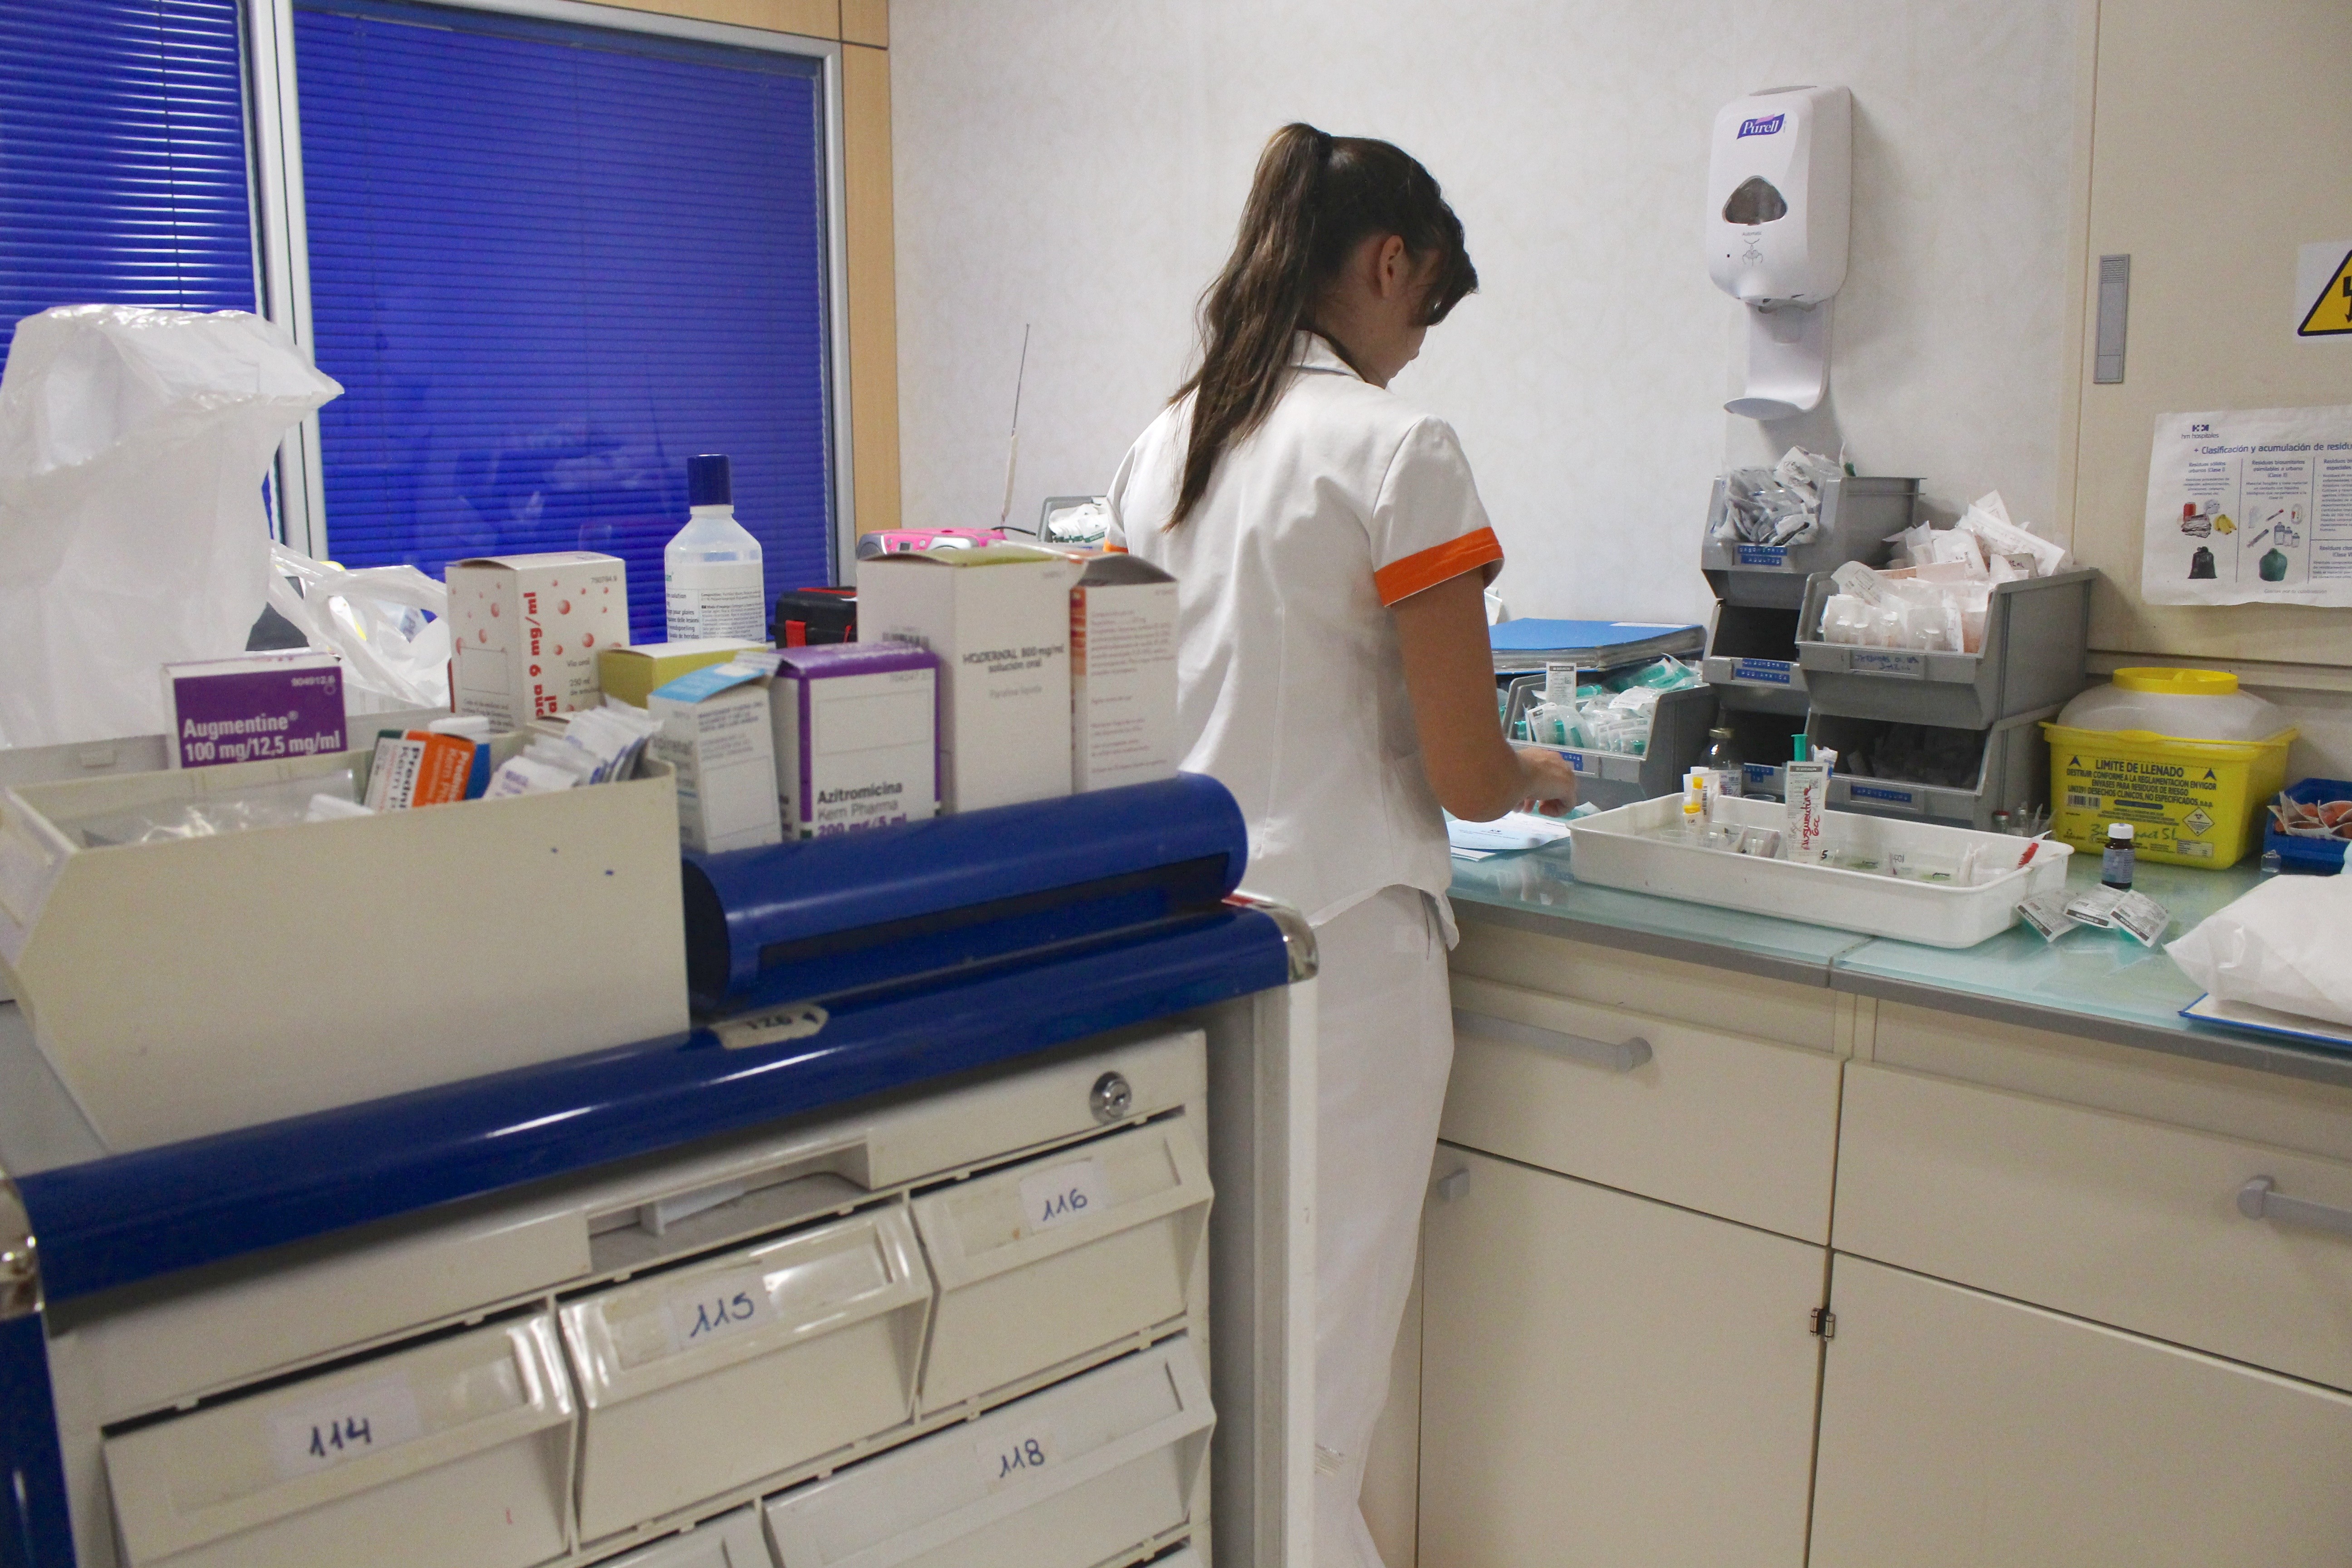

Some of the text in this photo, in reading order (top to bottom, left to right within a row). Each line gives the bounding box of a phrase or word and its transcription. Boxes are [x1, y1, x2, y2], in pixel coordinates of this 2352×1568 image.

[1743, 120, 1779, 134] Purell
[2201, 445, 2249, 454] Clasificación
[2258, 444, 2311, 452] acumulación
[523, 591, 543, 656] mg/ml
[569, 678, 582, 687] 250
[185, 742, 216, 762] 100
[288, 730, 341, 756] mg/ml
[2066, 768, 2092, 778] DESTRUIR
[2092, 771, 2124, 781] CONFORME
[2137, 775, 2189, 788] REGLAMENTACION
[2190, 780, 2199, 789] EN
[2200, 782, 2217, 790] VIGOR
[2096, 760, 2185, 778] LIMITE DE LLENADO
[817, 781, 903, 804] Azitromicina
[2088, 787, 2116, 797] DESECHOS
[2144, 793, 2153, 801] NO
[2092, 779, 2115, 789] ENVASES
[2116, 781, 2130, 790] PARA
[2131, 783, 2158, 793] RESIDUOS
[2168, 787, 2189, 796] RIESGO
[817, 799, 899, 821] Kern Pharma
[1042, 1188, 1088, 1223] 116
[690, 1293, 755, 1338] 115
[308, 1416, 372, 1459] 114
[999, 1438, 1045, 1478] 118
